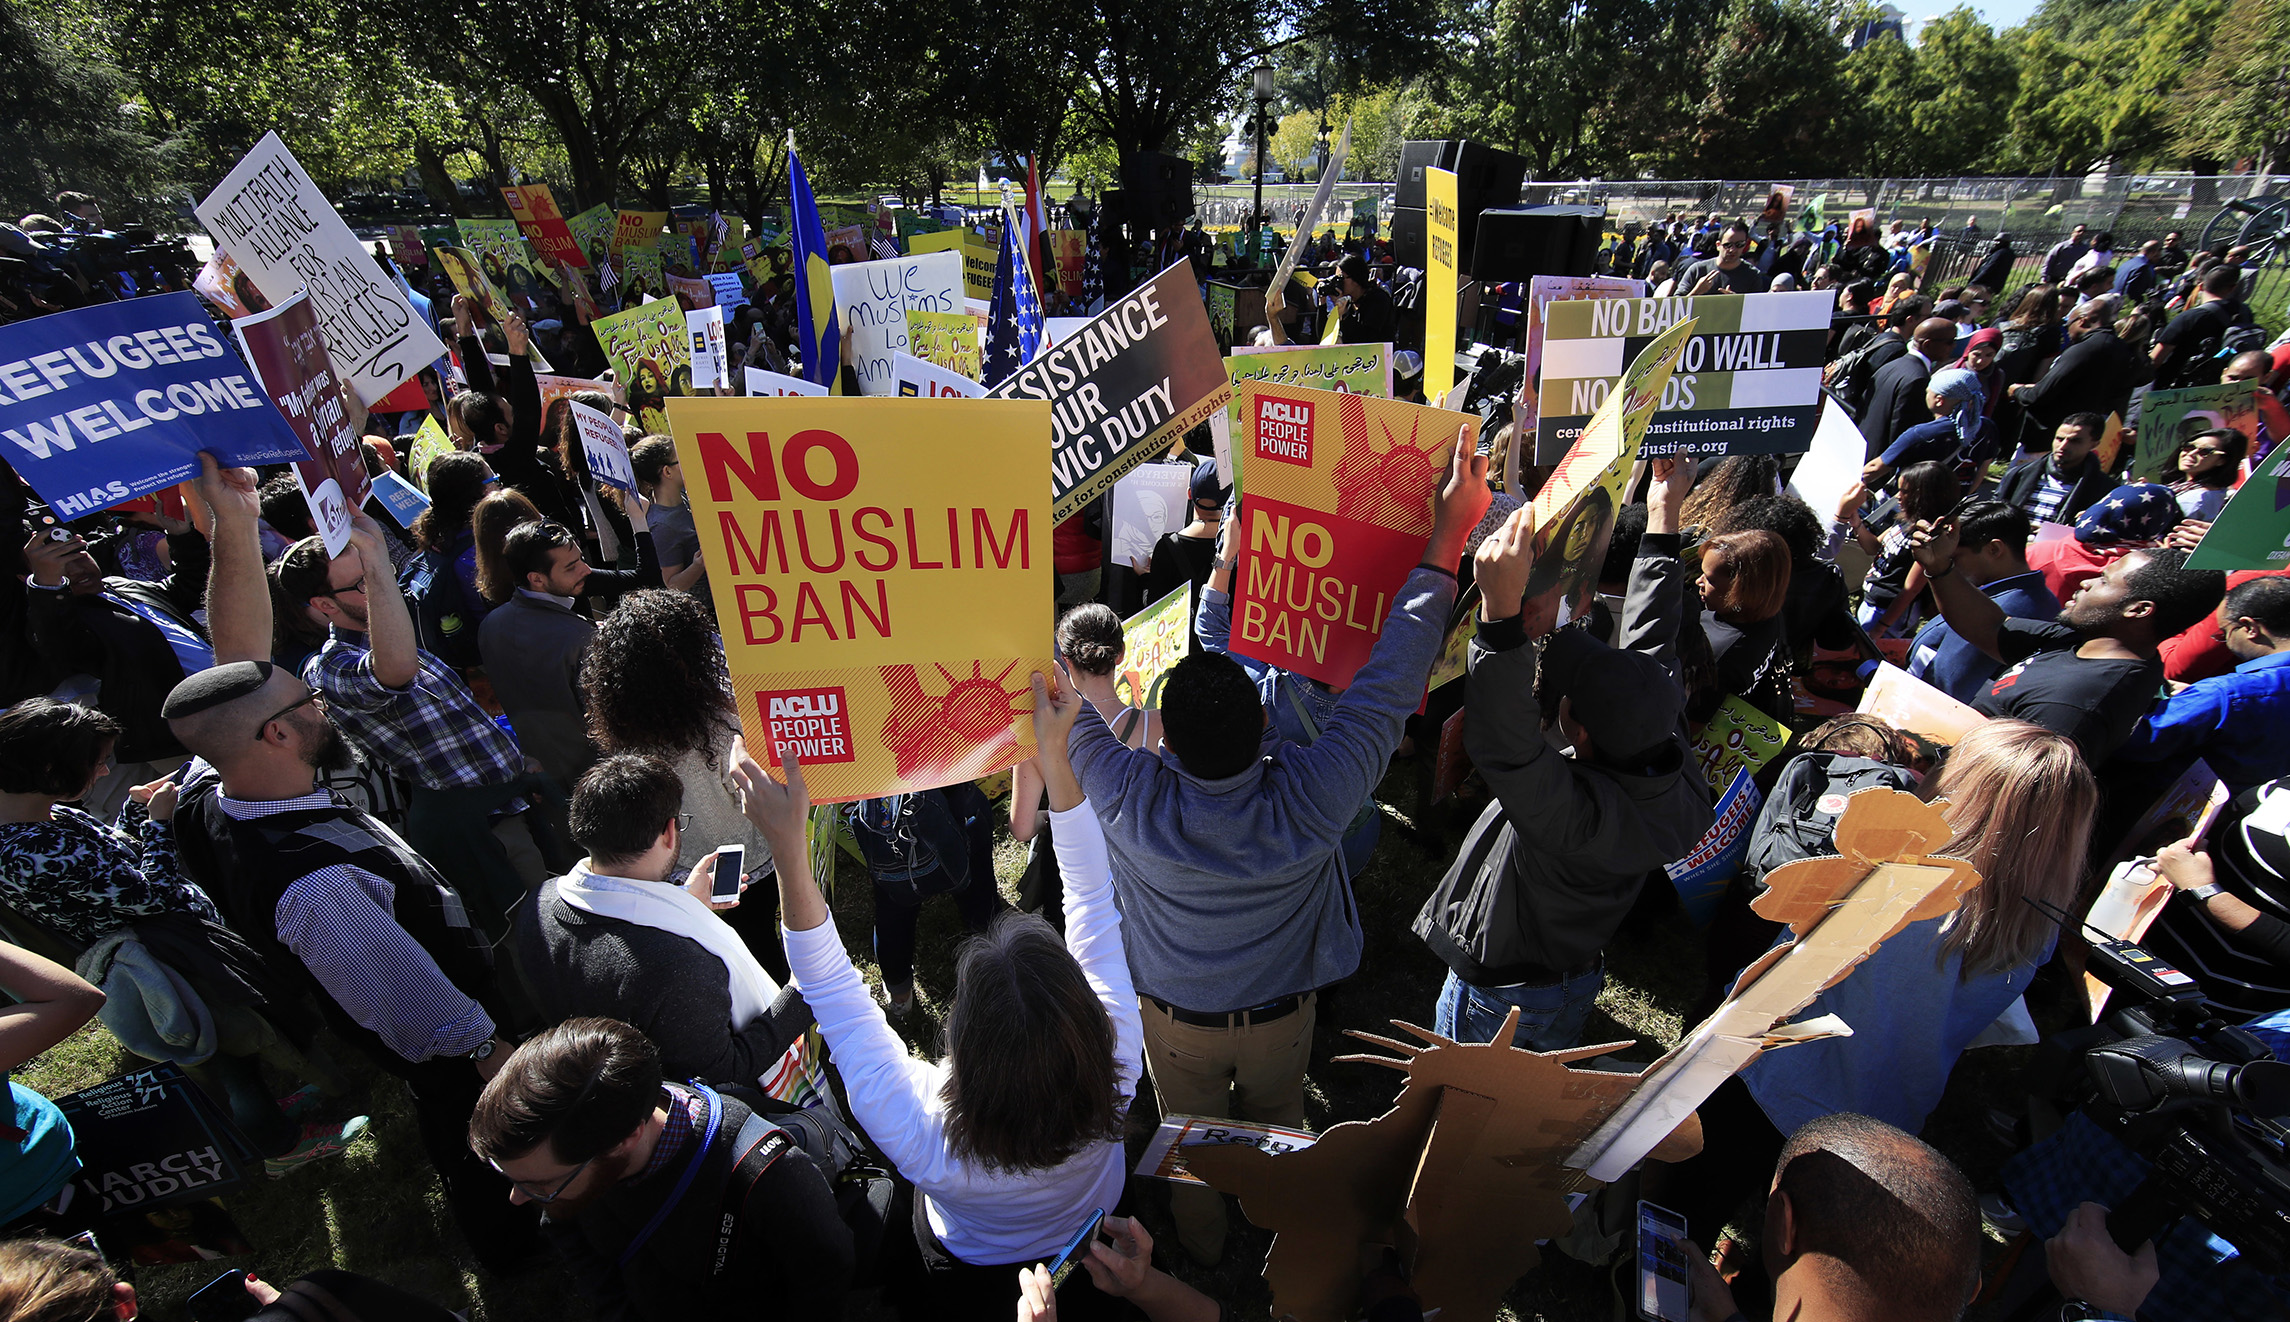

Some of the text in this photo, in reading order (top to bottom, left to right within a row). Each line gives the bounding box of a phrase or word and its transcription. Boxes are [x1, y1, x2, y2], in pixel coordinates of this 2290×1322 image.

[212, 154, 301, 247] MULTIFAITH
[249, 194, 319, 270] ALLIANCE
[522, 224, 543, 238] NO
[617, 226, 662, 239] MUSLIM
[620, 215, 643, 227] NO
[530, 236, 575, 252] MUSLIM
[289, 243, 327, 283] FOR
[866, 265, 926, 301] We
[965, 272, 994, 288] FUGEES
[321, 282, 410, 371] REFUGEES
[1591, 297, 1695, 337] NO BAN
[605, 335, 634, 358] Come
[637, 327, 653, 348] for
[647, 341, 661, 359] Us
[886, 328, 907, 348] Lo
[1000, 285, 1168, 400] SISTANCE
[1713, 333, 1786, 371] WALL
[279, 390, 307, 419] "My
[314, 369, 330, 392] was
[1571, 378, 1610, 416] NO
[1, 375, 263, 459] WELCOME
[575, 411, 614, 437] MY PEOPLE
[1260, 400, 1309, 425] ACLU
[309, 422, 320, 448] a
[331, 419, 356, 459] refug
[1052, 376, 1176, 498] VIC DUTY
[1260, 421, 1308, 444] PEOPLE
[1556, 415, 1796, 440] cen onstitutional rights
[236, 448, 303, 462] #JewsForRefugees
[1053, 503, 1073, 525] ter
[1074, 487, 1095, 508] for
[1097, 419, 1189, 491] constitutional
[1191, 389, 1233, 425] rights
[1260, 436, 1308, 460] POWER
[1636, 440, 1728, 463] rjustie.org
[129, 462, 195, 488] Welcome the stranger.
[696, 429, 859, 502] NO
[133, 470, 192, 492] Protect the refugee.
[55, 480, 130, 516] HIAS
[388, 489, 411, 503] REFU
[395, 495, 420, 511] WELC
[717, 506, 1030, 576] MUSLIM
[1250, 508, 1334, 569] NO
[1247, 556, 1385, 635] MUSLI
[734, 579, 892, 646] BAN
[1241, 600, 1330, 665] BAN
[769, 693, 839, 719] ACLU
[770, 717, 843, 740] PEOPLE
[775, 737, 847, 759] POWER
[1687, 803, 1754, 869] WELCOME
[1684, 868, 1705, 882] WHEN
[1706, 860, 1721, 871] SHE
[77, 1081, 124, 1100] Religious
[85, 1091, 132, 1109] Religious
[97, 1105, 131, 1118] Center
[101, 1097, 134, 1111] Action
[111, 1110, 134, 1119] Reform
[133, 1103, 158, 1114] Judaism
[102, 1162, 223, 1213] UDLY
[2275, 1209, 2290, 1223] SO
[713, 1212, 735, 1276] EOS DIGITAL
